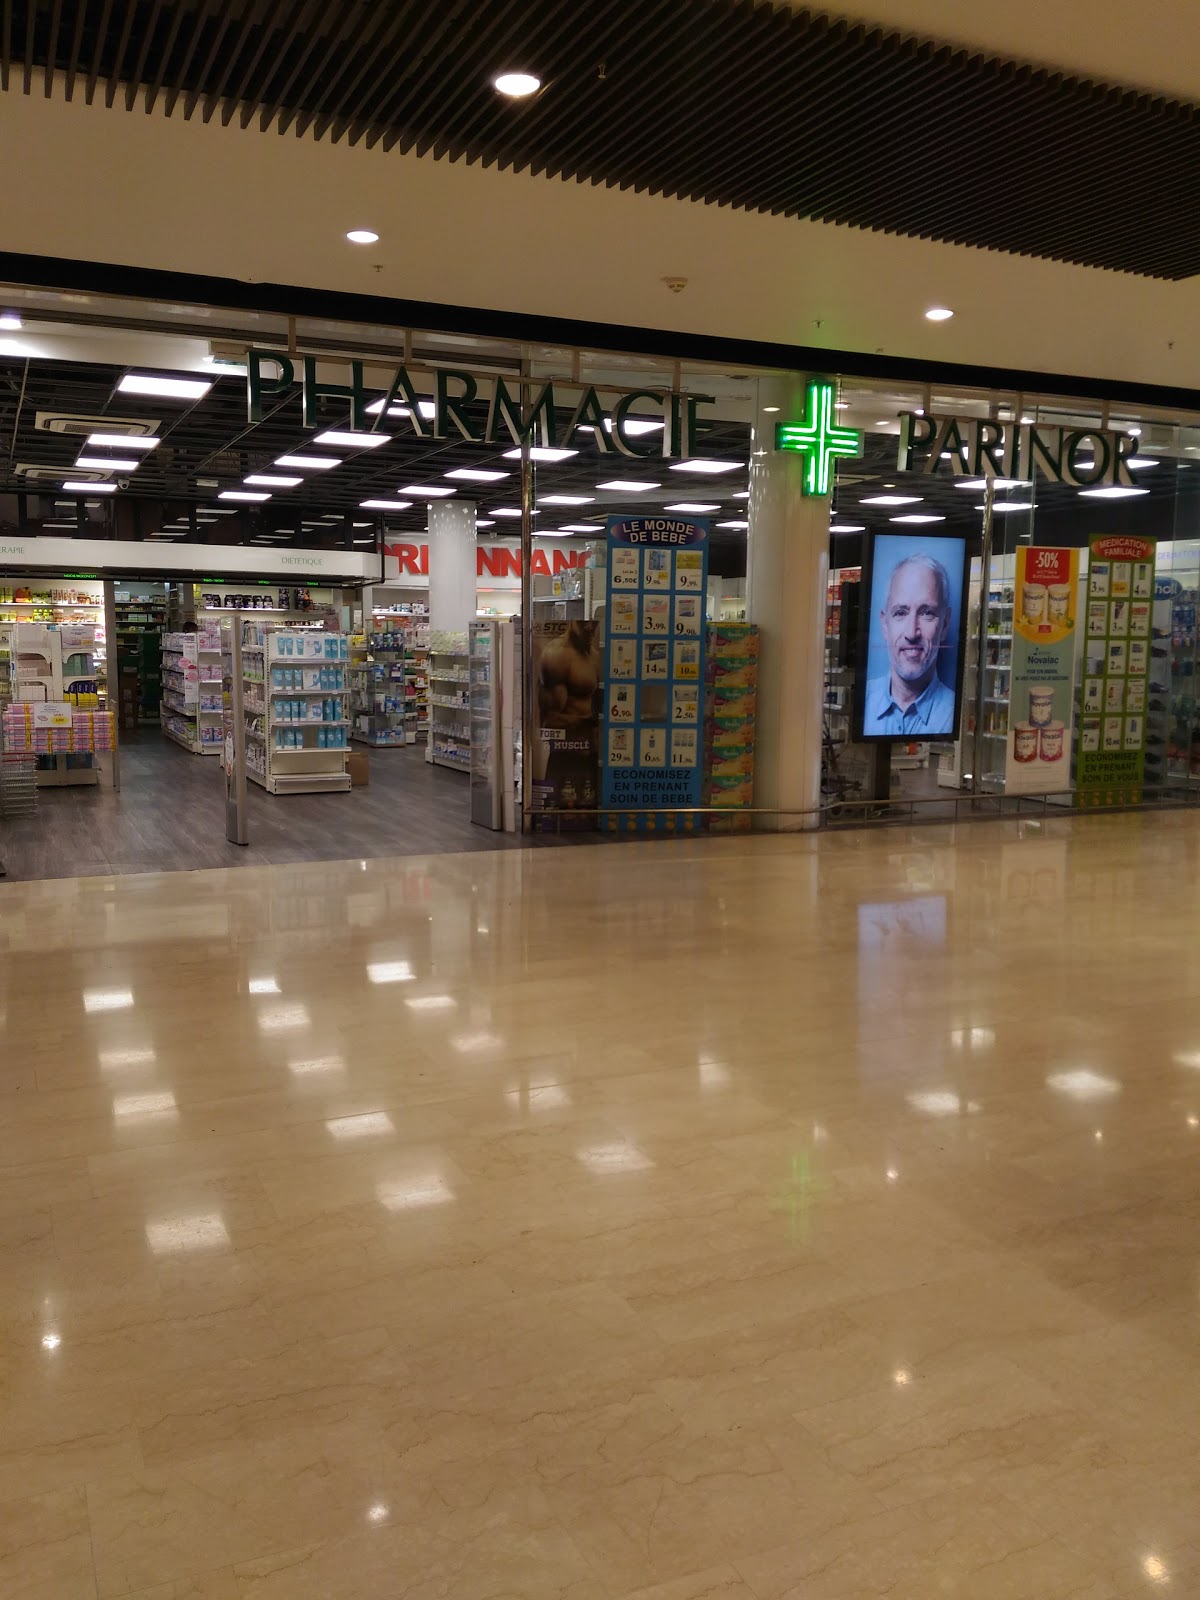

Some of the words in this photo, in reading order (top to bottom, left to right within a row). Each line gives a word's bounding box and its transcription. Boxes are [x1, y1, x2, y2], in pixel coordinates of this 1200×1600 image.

[247, 350, 714, 460] PHARMACIE
[897, 411, 1139, 487] PARINOR
[622, 521, 640, 533] LE
[644, 520, 695, 535] MONDE
[630, 531, 648, 543] DE
[651, 531, 687, 544] BEBE
[1099, 538, 1148, 551] MEDICATION
[1104, 547, 1142, 558] FAMILIALE
[1035, 552, 1059, 569] -50%
[544, 622, 567, 631] STC
[1027, 655, 1060, 664] Novalac
[540, 730, 561, 738] FORT
[554, 739, 590, 750] MUSCLÉ
[1085, 752, 1138, 762] ECONOMISEZ
[1085, 764, 1098, 772] EN
[1099, 762, 1136, 772] PRENANT
[613, 770, 691, 779] ECONOMISEZ
[1082, 774, 1101, 783] SOIN
[1103, 774, 1115, 782] DE
[1117, 773, 1139, 781] VOUS
[614, 782, 633, 791] EN
[634, 782, 689, 791] PRENANT
[610, 794, 638, 803] SOIN
[642, 794, 657, 803] DE
[662, 794, 693, 803] BEBE
